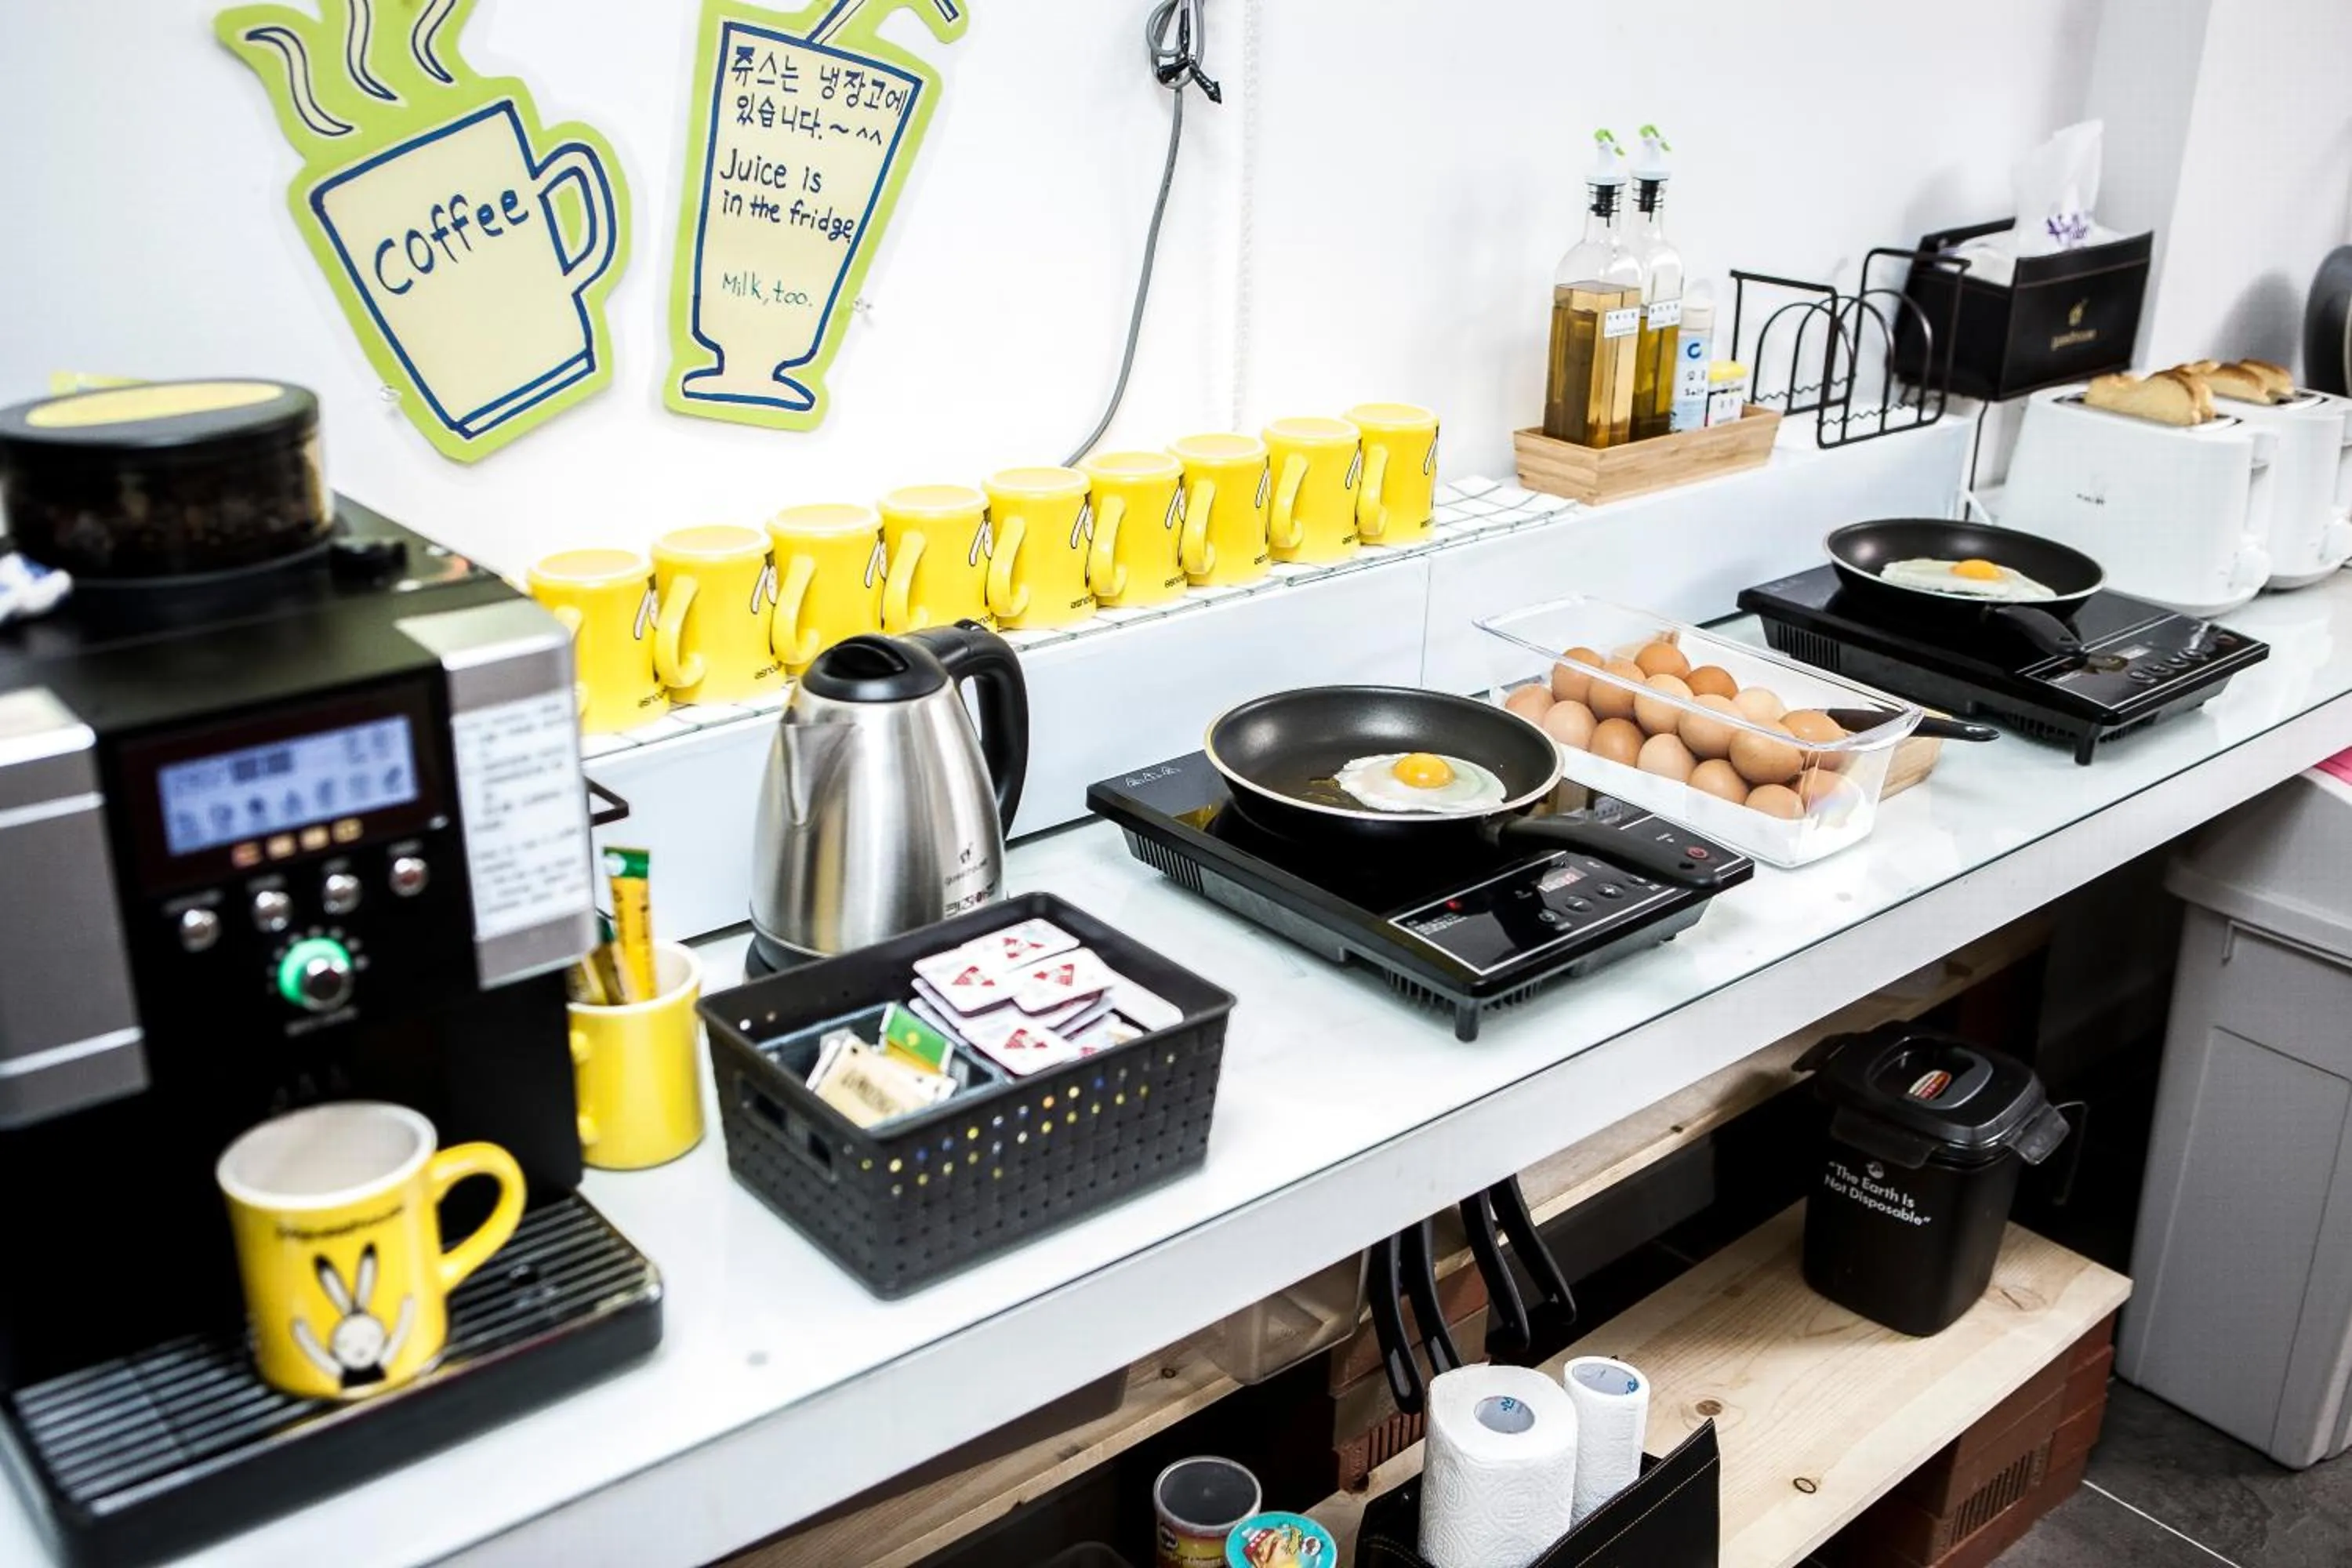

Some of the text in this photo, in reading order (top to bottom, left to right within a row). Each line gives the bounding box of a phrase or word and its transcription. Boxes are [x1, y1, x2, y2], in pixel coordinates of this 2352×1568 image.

[819, 64, 909, 117] 냉장고에
[719, 147, 787, 189] Juice
[722, 189, 743, 217] in
[750, 194, 781, 223] the
[1824, 1173, 1847, 1194] Not
[1861, 1176, 1899, 1203] Earth
[1902, 1192, 1915, 1209] Is
